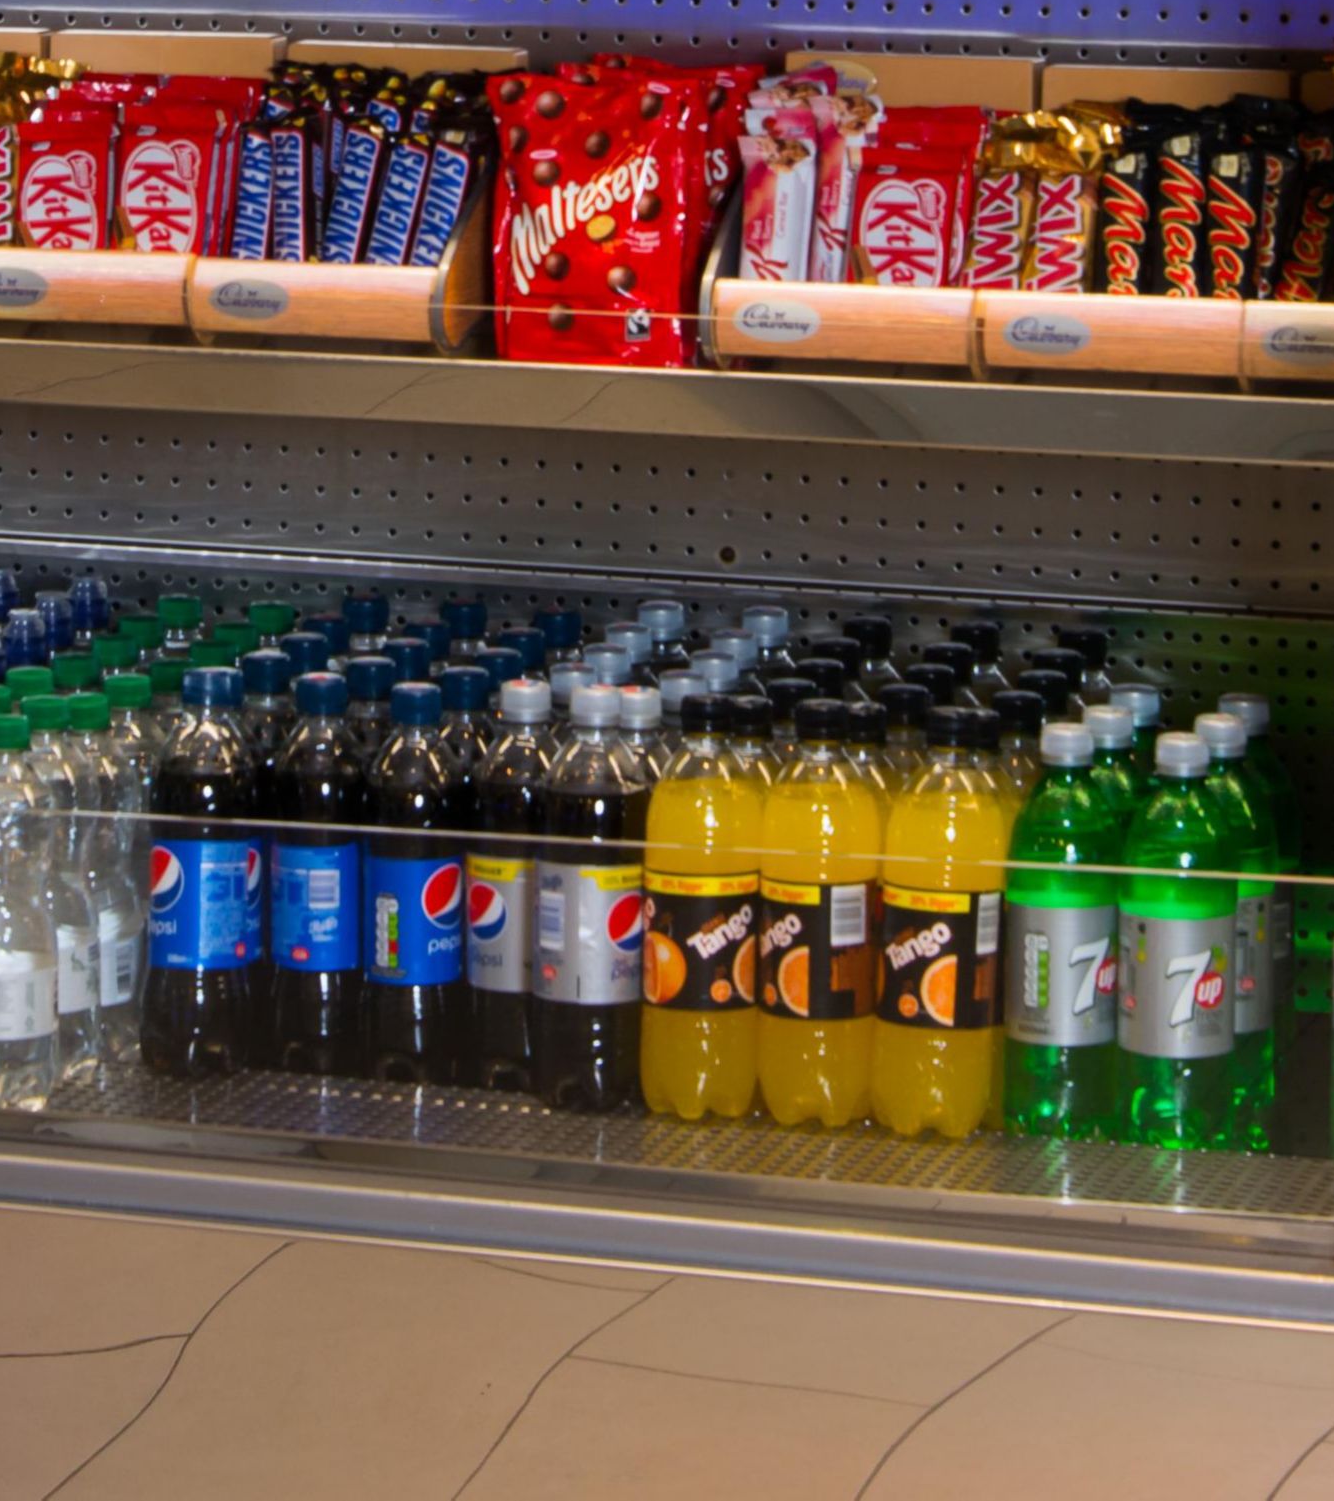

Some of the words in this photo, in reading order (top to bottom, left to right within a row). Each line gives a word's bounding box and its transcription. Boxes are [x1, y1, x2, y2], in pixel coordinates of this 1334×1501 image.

[27, 174, 92, 249] KitKa
[369, 143, 428, 266] NICKERS
[412, 144, 469, 267] SNICKE
[511, 155, 659, 295] Maltesers
[866, 201, 937, 284] KitKa
[1158, 155, 1206, 298] Mar
[428, 935, 460, 956] pep
[686, 903, 754, 960] Tango
[762, 913, 802, 959] ngo
[884, 922, 953, 971] Tango
